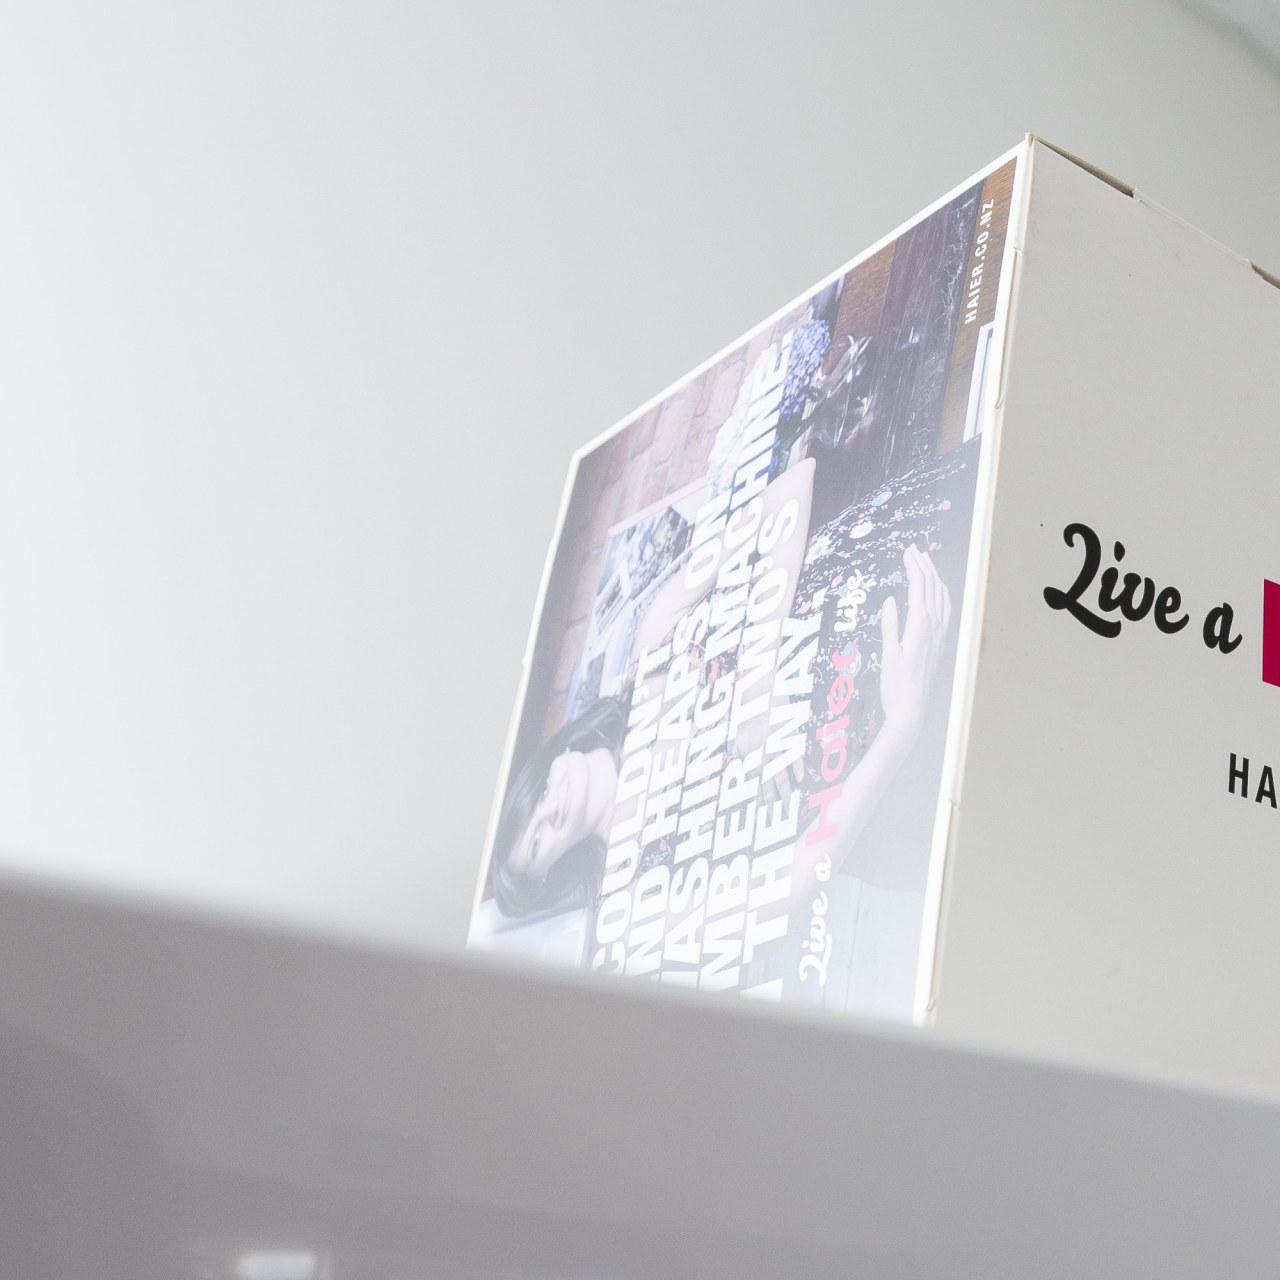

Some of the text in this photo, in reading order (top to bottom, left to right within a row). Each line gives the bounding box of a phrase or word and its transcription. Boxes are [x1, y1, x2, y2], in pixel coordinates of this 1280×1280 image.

[965, 198, 994, 325] HAIER.CO.NZ
[704, 329, 793, 662] MACHINE.
[1043, 522, 1190, 639] Live
[1202, 602, 1243, 654] a
[728, 499, 799, 743] TWO'S
[762, 586, 829, 784] WAY.
[624, 490, 733, 983] ND HEAPS ON
[799, 568, 868, 987] Live a Haier life
[743, 788, 801, 964] THE
